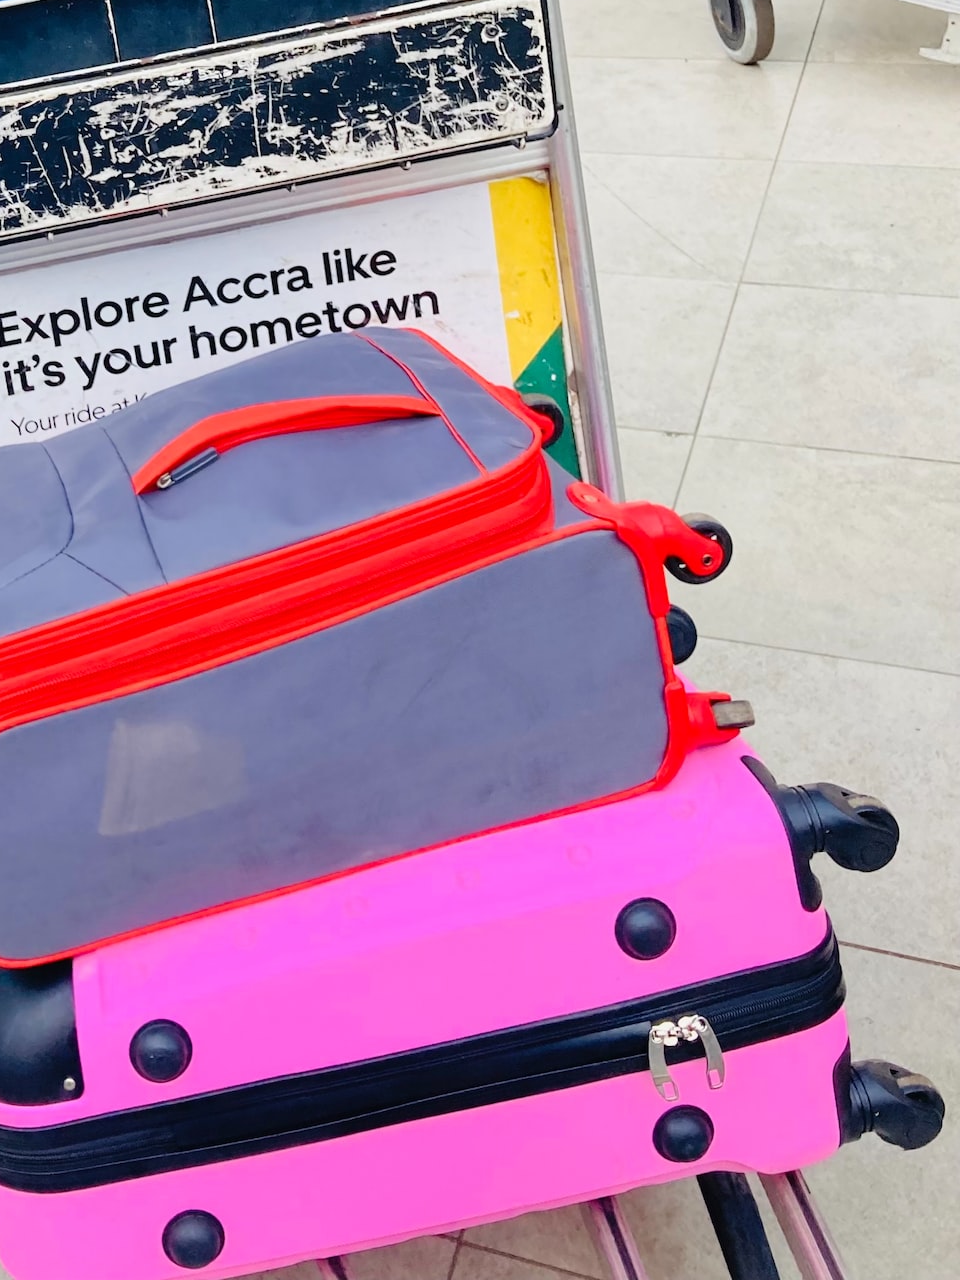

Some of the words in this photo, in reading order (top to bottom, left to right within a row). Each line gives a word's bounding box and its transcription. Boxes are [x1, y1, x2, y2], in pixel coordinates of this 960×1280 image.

[182, 265, 313, 313] Accra
[322, 247, 397, 286] like
[2, 348, 66, 396] it’s
[75, 337, 177, 391] your
[188, 290, 440, 359] hometown
[10, 412, 58, 436] Your
[64, 403, 106, 426] ride
